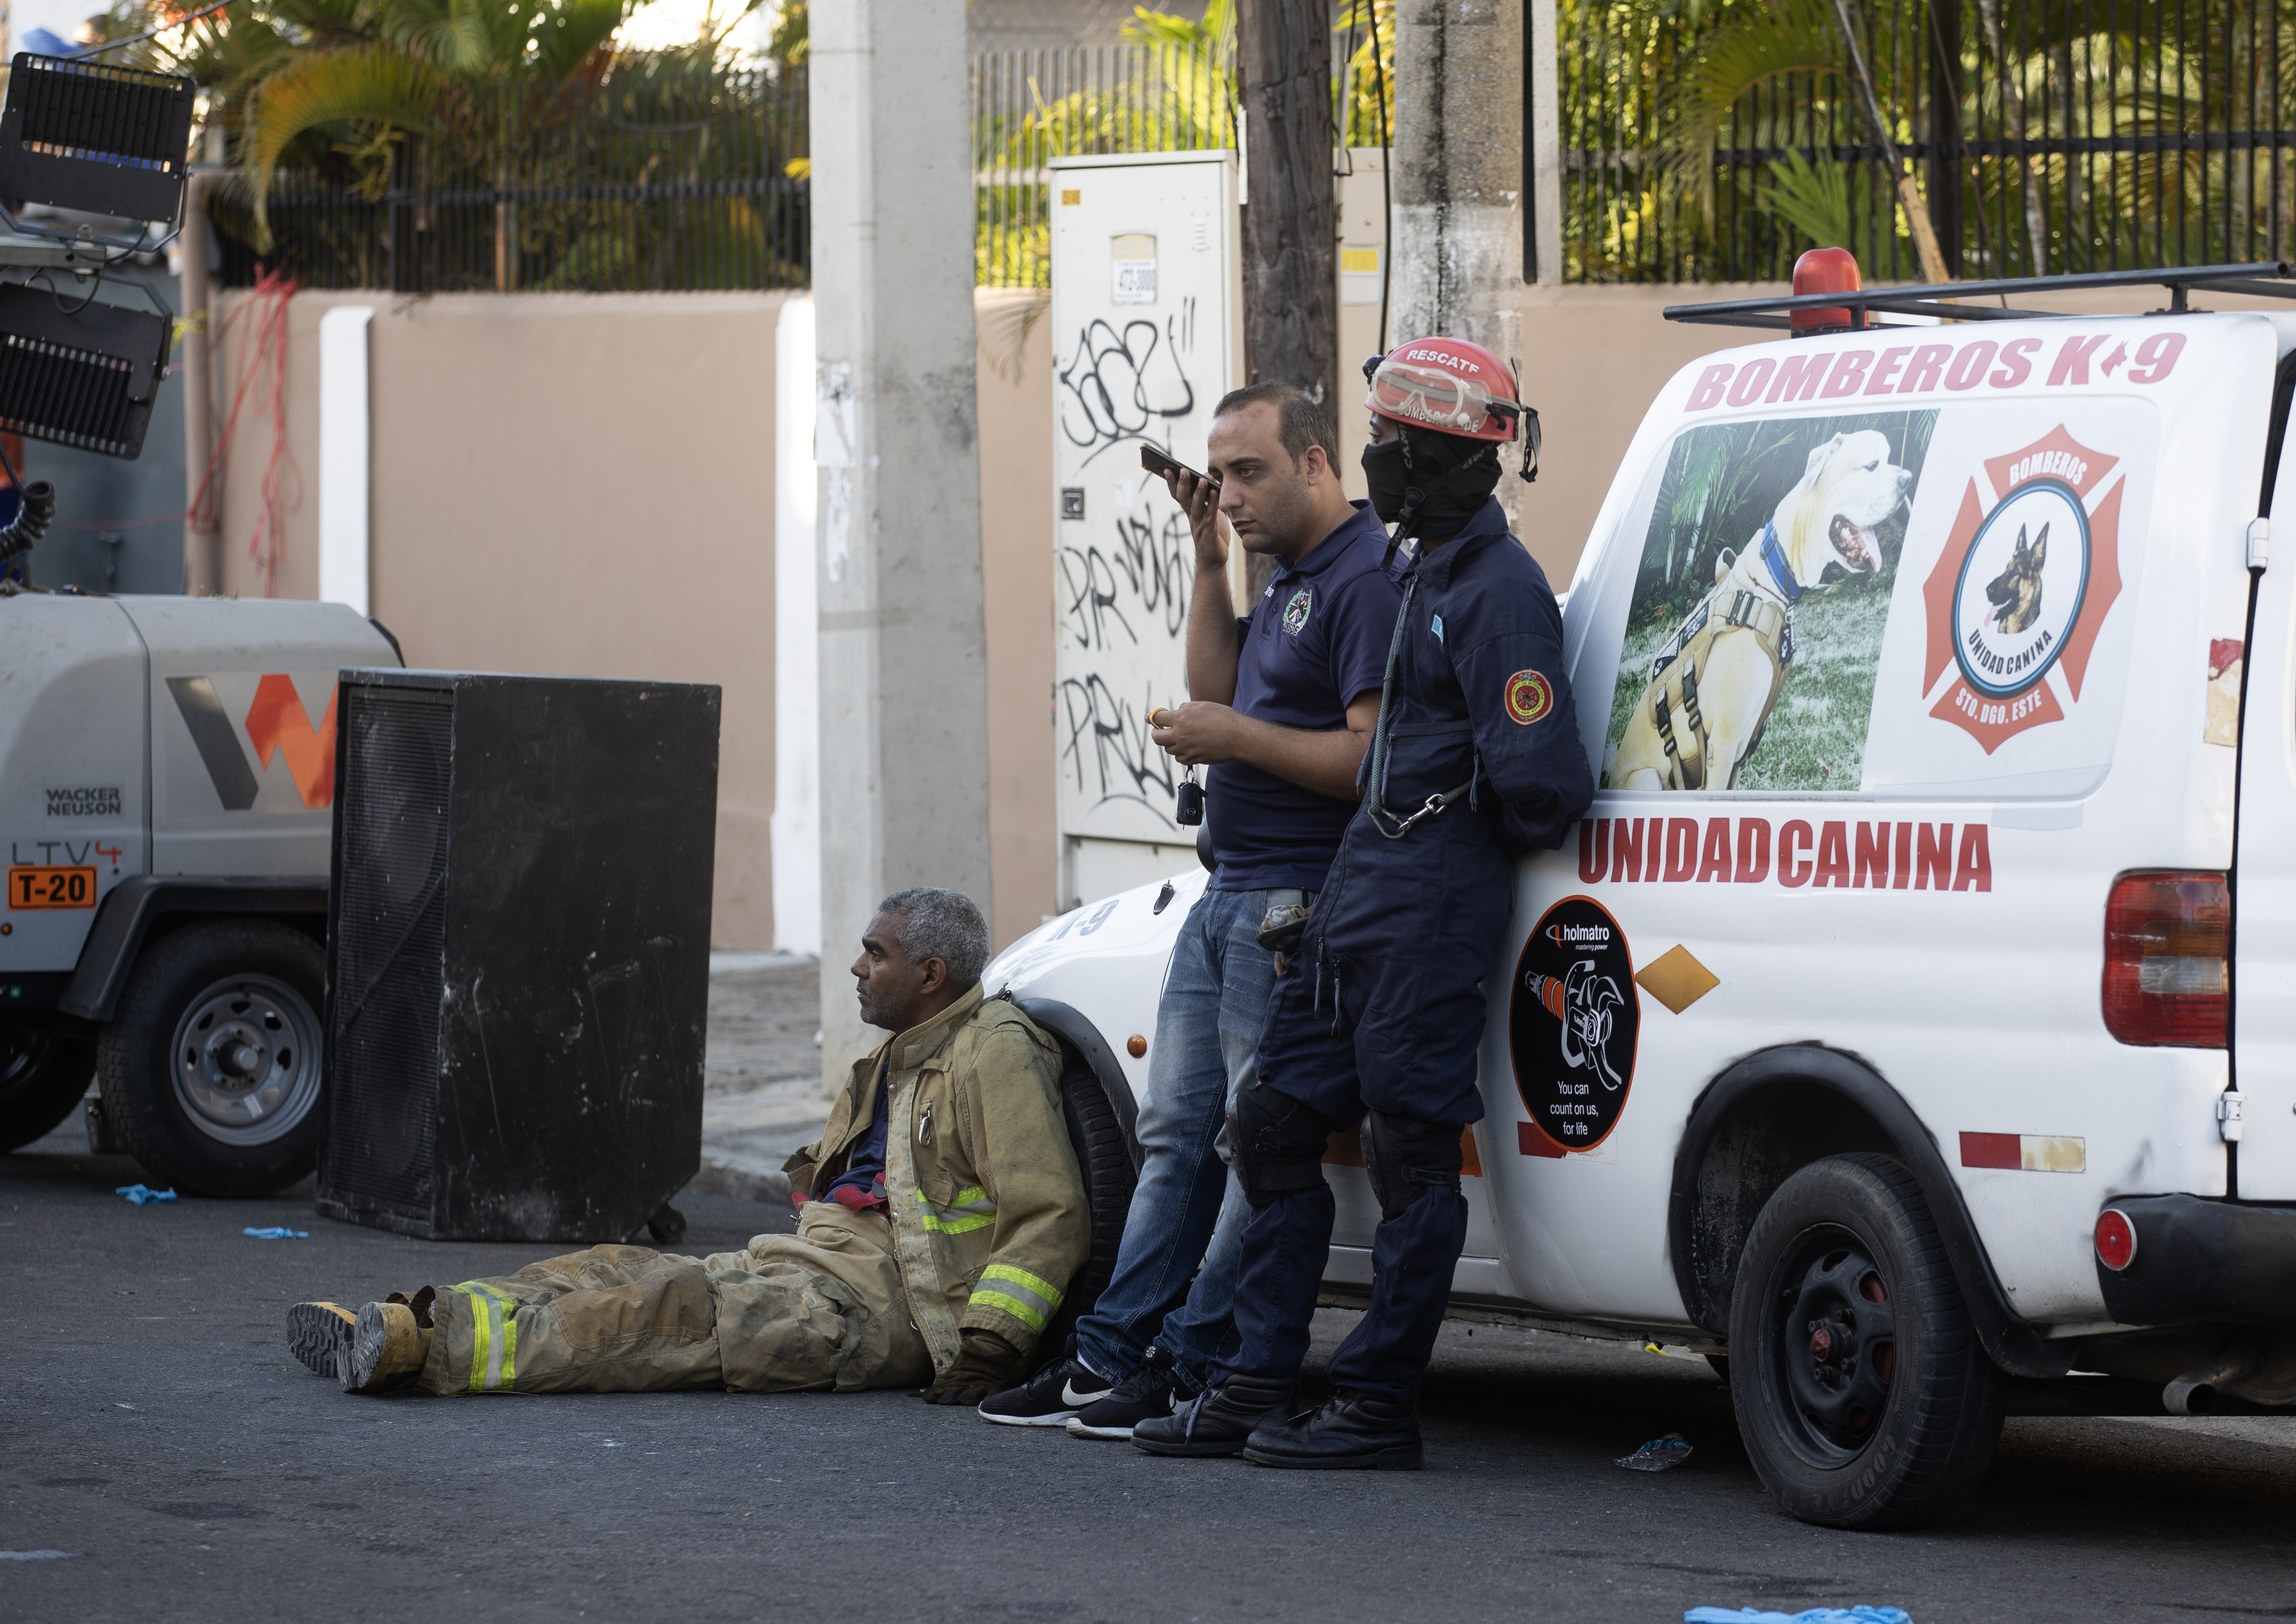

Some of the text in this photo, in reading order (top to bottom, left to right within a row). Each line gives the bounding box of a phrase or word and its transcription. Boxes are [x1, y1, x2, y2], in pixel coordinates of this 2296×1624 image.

[1683, 338, 2043, 412] BOMBEROS
[2008, 450, 2088, 487] BOMBEROS
[1968, 628, 2053, 675] UNIDAD CANINA
[1528, 681, 1544, 700] BOMBEROS
[1955, 686, 2043, 725] STO. DGO. ESTE
[46, 787, 121, 802] WACKER
[46, 802, 122, 816] NEUSON
[11, 840, 122, 867] LTV4
[18, 874, 86, 904] T-20
[1564, 924, 1610, 941] holmatro
[1575, 943, 1594, 951] mastering
[1557, 1081, 1589, 1096] You can
[1550, 1102, 1599, 1117] count on us,
[1563, 1122, 1588, 1136] for life
